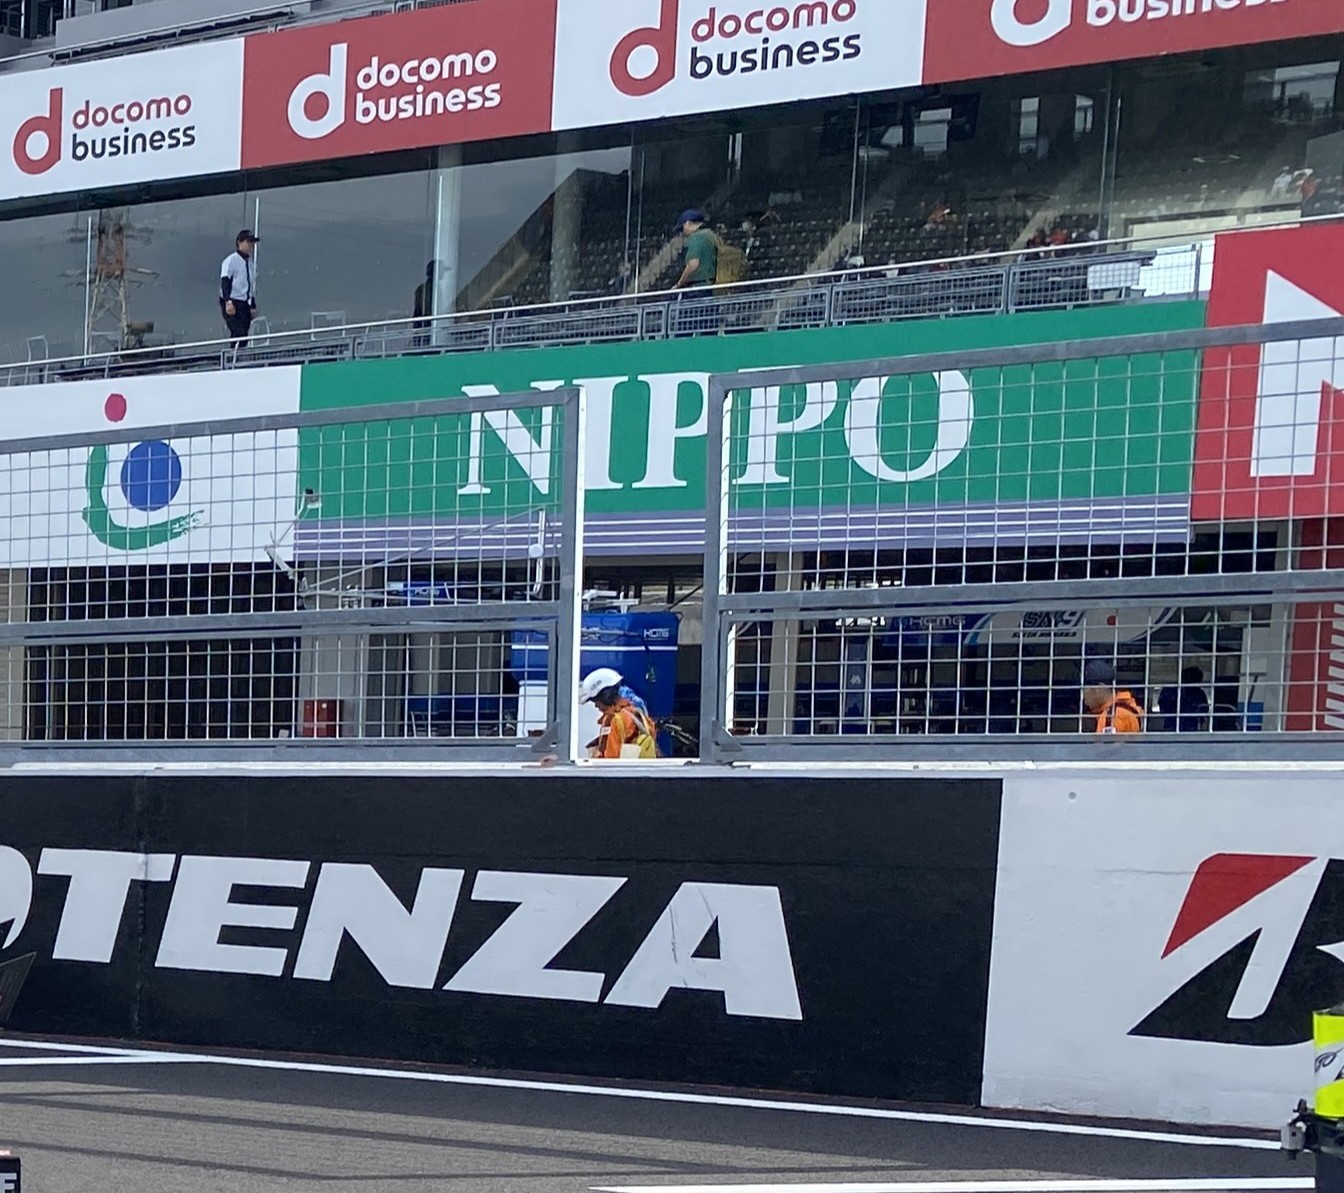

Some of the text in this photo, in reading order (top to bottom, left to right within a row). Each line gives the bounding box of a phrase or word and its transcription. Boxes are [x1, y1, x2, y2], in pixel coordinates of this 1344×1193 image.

[356, 46, 498, 88] docomo
[689, 34, 862, 79] business
[72, 91, 192, 130] docomo
[356, 81, 502, 123] business
[71, 122, 197, 162] business
[457, 367, 975, 496] NIPPO
